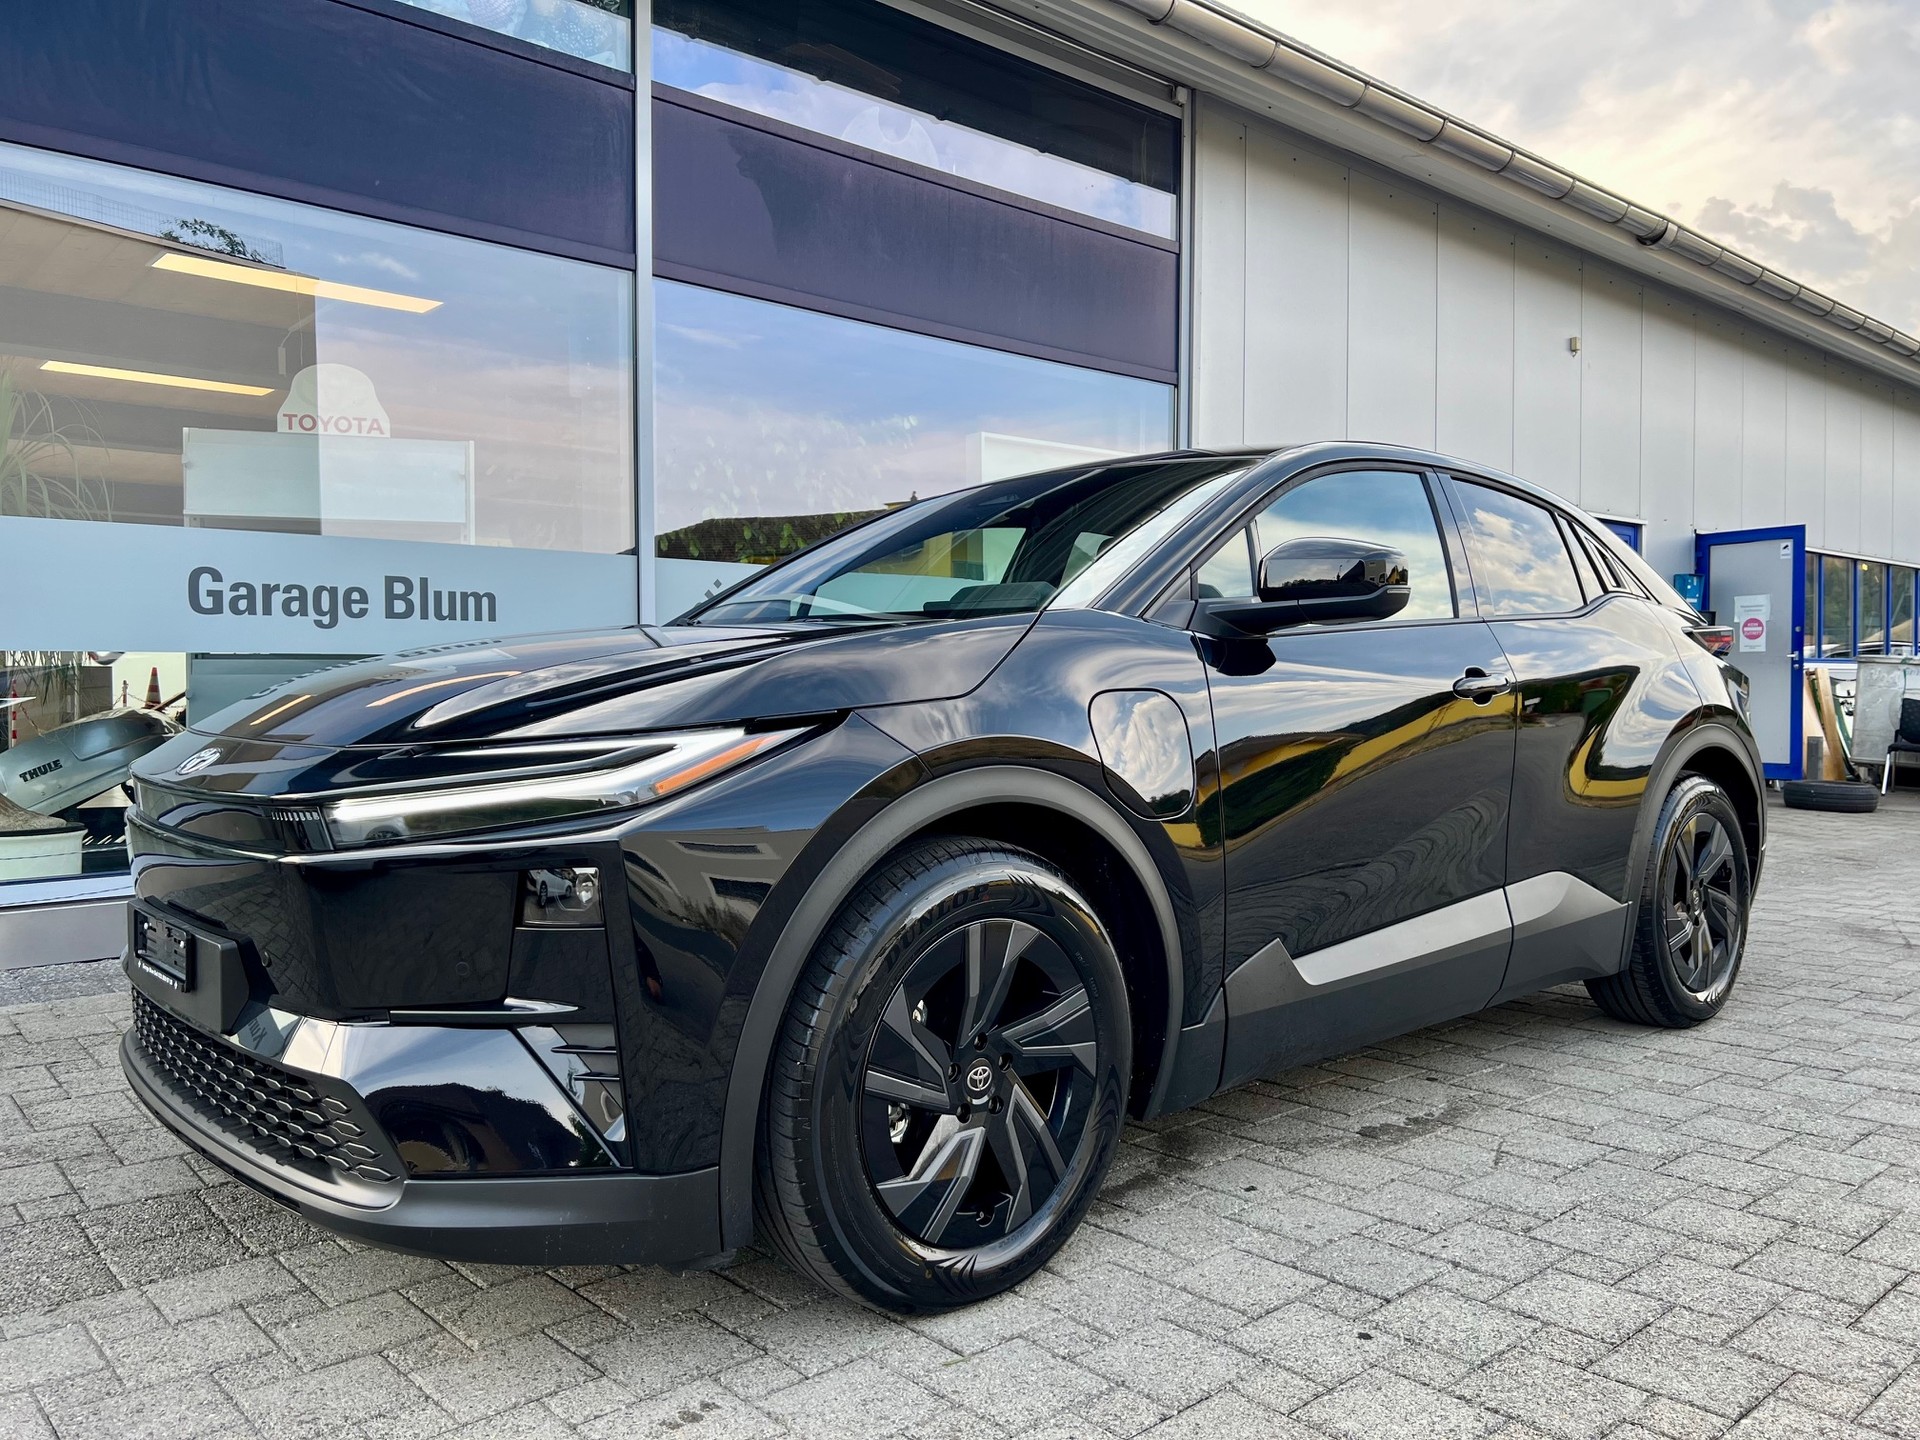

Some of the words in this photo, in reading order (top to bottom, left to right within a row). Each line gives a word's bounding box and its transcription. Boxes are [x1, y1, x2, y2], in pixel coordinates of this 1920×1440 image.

[282, 413, 385, 435] TOYOTA
[188, 566, 369, 630] Garage
[384, 575, 497, 622] Blum
[18, 758, 63, 783] THULE
[884, 883, 990, 974] DUNLOP
